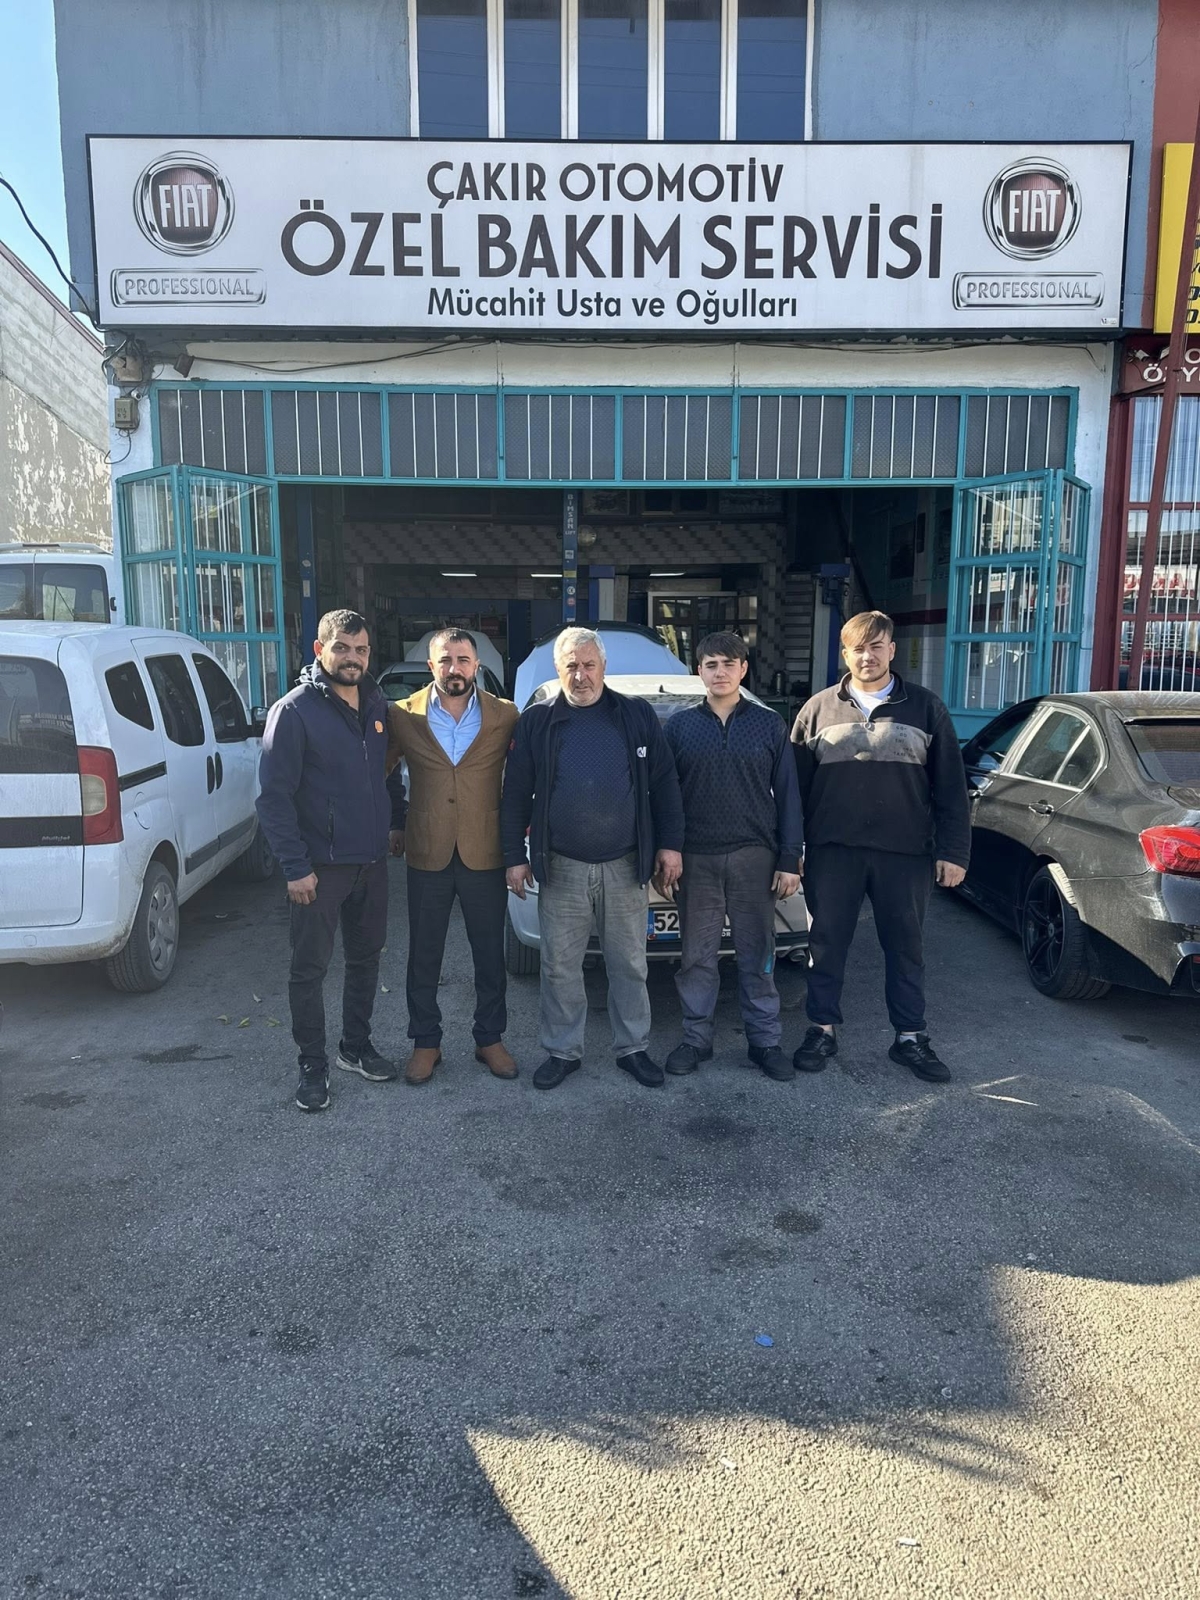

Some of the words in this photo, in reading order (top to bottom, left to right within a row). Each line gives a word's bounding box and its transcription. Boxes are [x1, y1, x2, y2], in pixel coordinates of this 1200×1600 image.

[427, 161, 546, 208] ÇAKIR
[560, 157, 784, 203] OTOMOTİV
[159, 184, 212, 227] FIAT
[1009, 189, 1061, 232] FIAT
[280, 199, 460, 277] ÖZEL
[477, 213, 681, 279] BAKIM
[700, 203, 943, 280] SERVİSİ
[124, 278, 254, 296] PROFESSIONAL
[428, 287, 546, 317] Mücahit
[557, 289, 621, 318] Usta
[632, 297, 666, 318] ve
[676, 288, 797, 325] Oğulları
[966, 281, 1092, 299] PROFESSIONAL
[654, 912, 679, 932] 52
